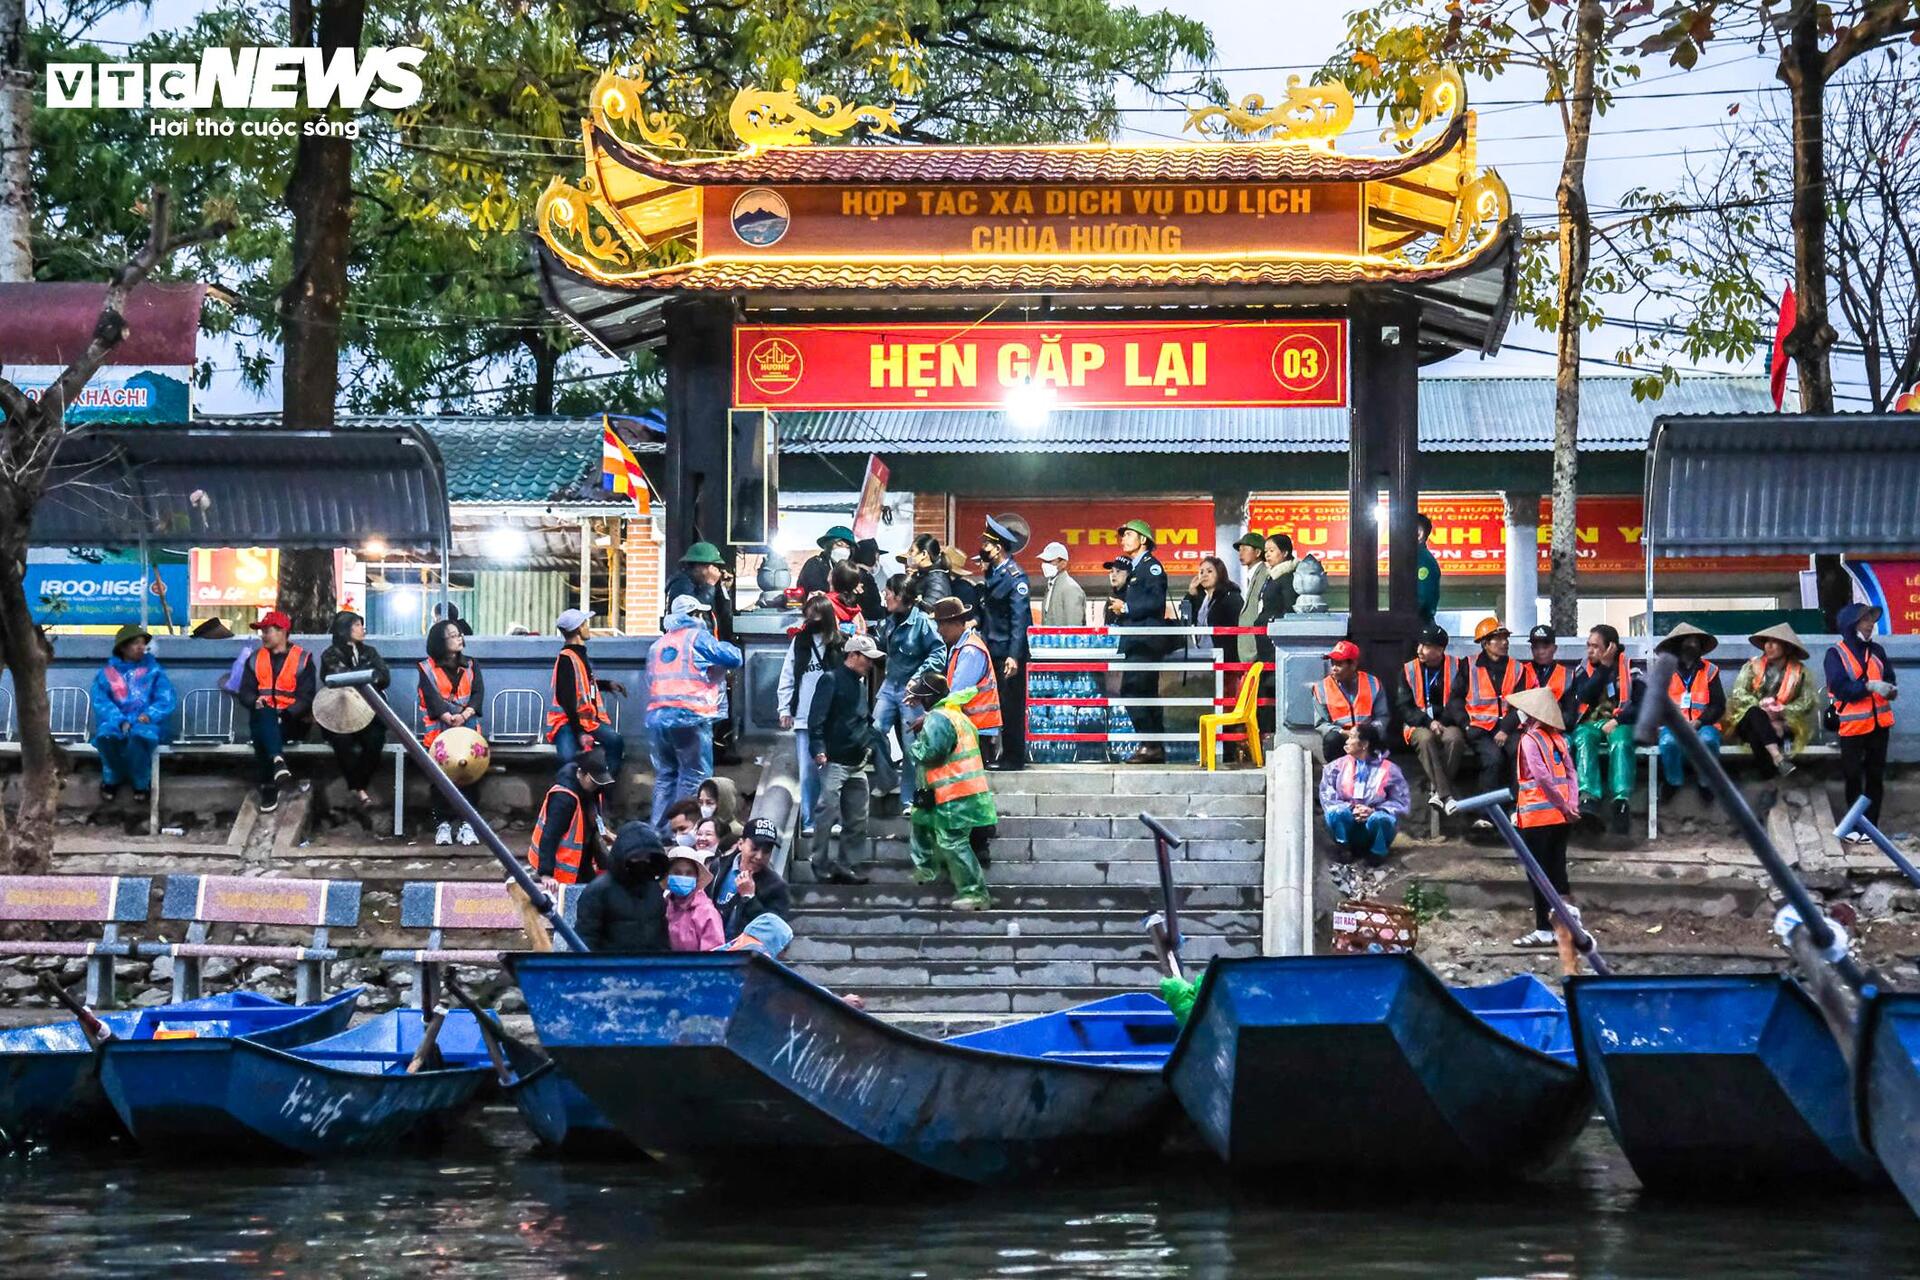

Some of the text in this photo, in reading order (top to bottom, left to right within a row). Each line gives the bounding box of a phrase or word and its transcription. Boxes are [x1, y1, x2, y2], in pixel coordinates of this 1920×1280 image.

[841, 188, 907, 220] HỢP
[1045, 190, 1122, 220] DỊCH
[1133, 190, 1174, 219] VỤ
[1184, 189, 1228, 213] DU
[1239, 188, 1311, 218] LỊCH
[971, 217, 1182, 253] CHÙA HƯƠNG
[869, 333, 1207, 398] HẸN GẶP LẠI
[1282, 347, 1319, 379] 03
[1060, 528, 1198, 545] TRM
